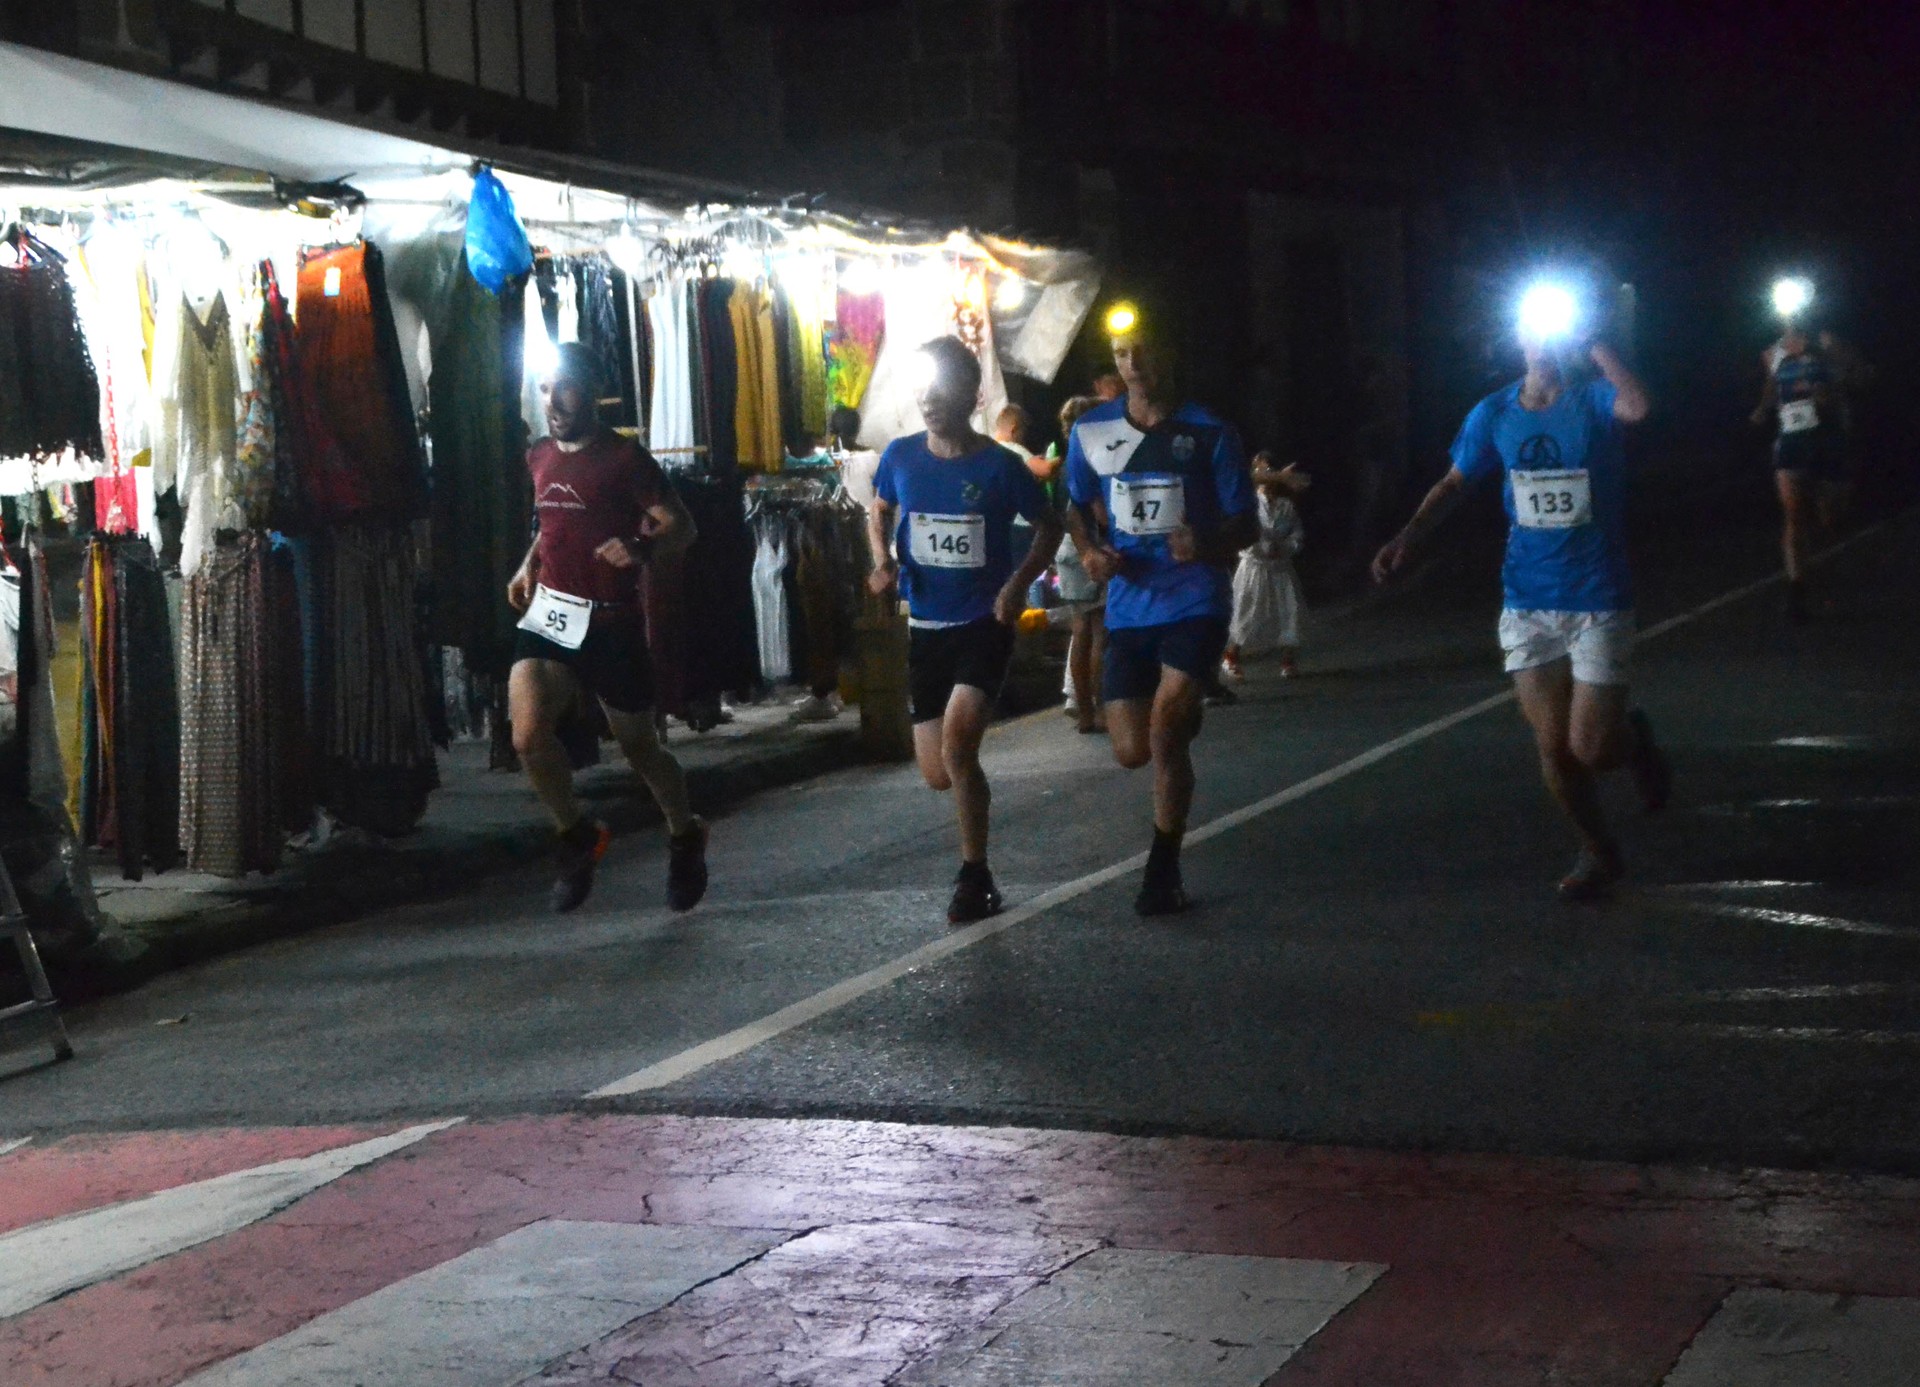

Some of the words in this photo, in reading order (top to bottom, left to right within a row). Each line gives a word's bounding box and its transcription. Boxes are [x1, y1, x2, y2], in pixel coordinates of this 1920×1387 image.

[1132, 500, 1161, 521] 47
[1529, 492, 1574, 514] 133
[928, 533, 970, 555] 146
[545, 610, 567, 632] 95
